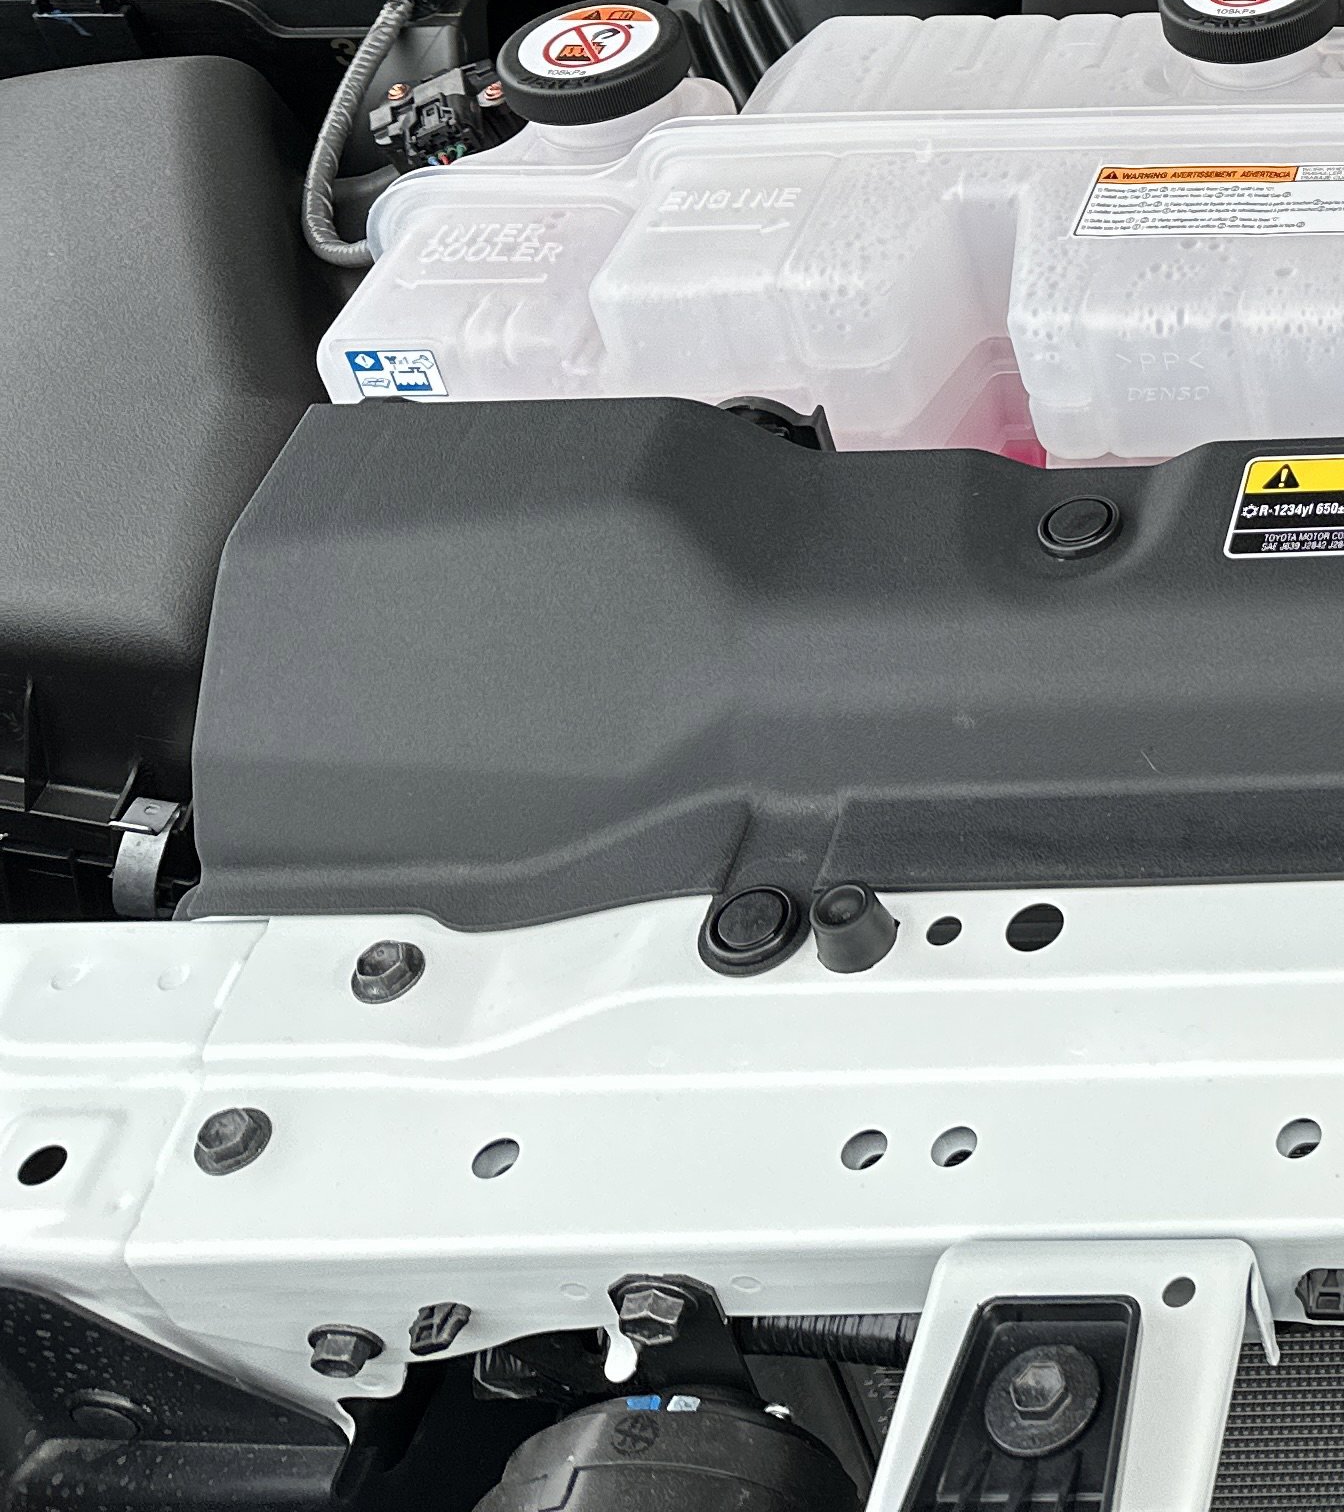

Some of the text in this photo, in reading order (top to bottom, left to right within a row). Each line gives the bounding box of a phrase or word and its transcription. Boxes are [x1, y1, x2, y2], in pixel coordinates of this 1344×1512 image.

[1122, 171, 1169, 180] WARNING
[1170, 170, 1238, 179] AVERTISSEMENT
[1239, 170, 1292, 179] ADVERTENCIA
[660, 187, 802, 211] ENGINE
[427, 222, 546, 245] INTER
[417, 242, 564, 264] COOLER
[1127, 385, 1211, 403] DENSO
[1258, 503, 1313, 518] R-1234yf
[1264, 532, 1297, 542] TOYOTA
[1298, 531, 1330, 541] MOTOR
